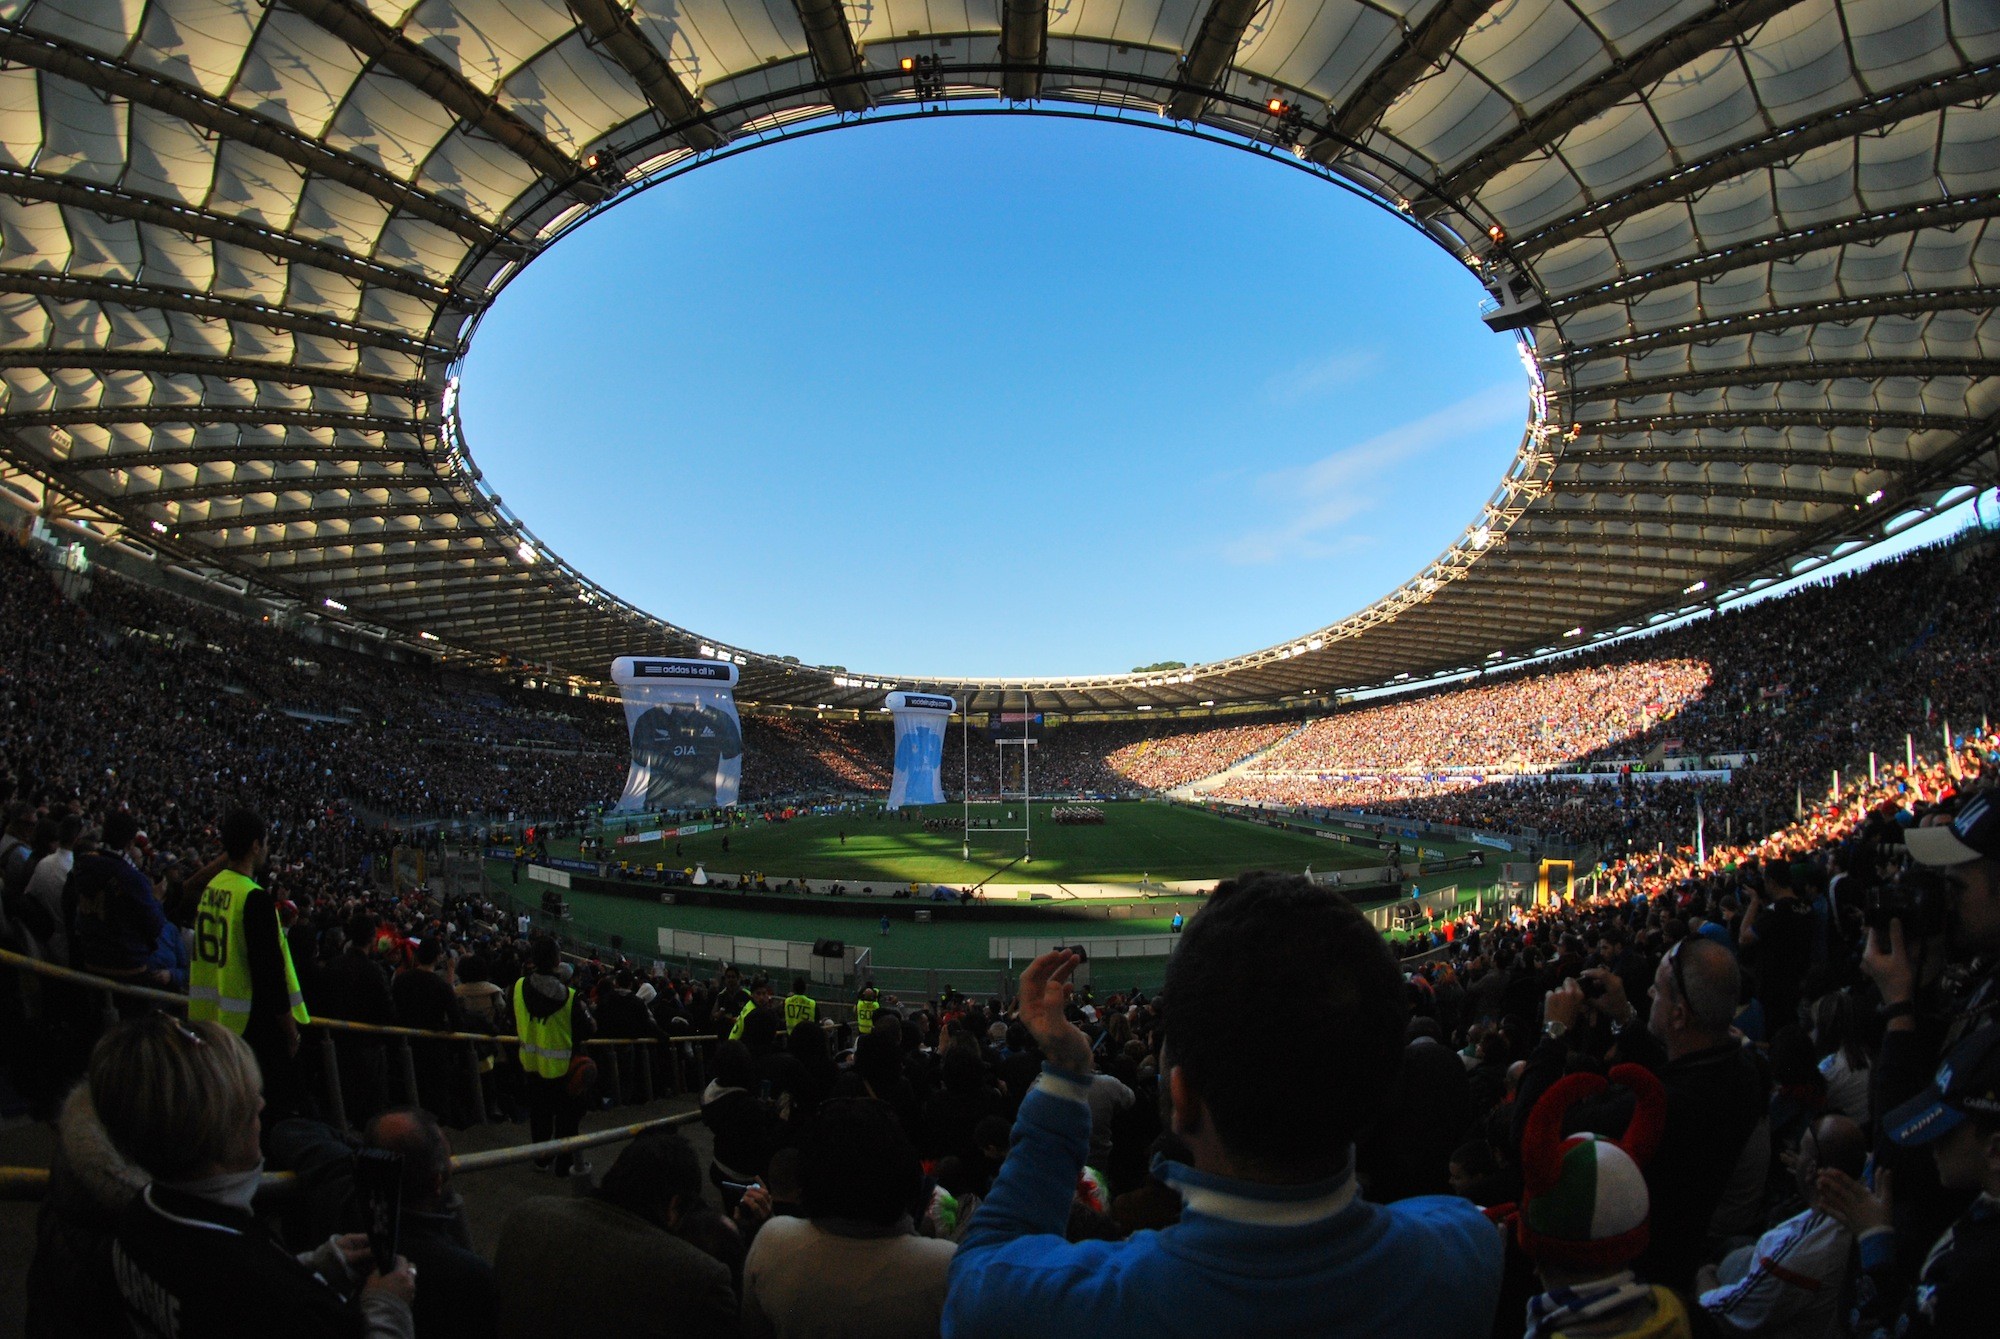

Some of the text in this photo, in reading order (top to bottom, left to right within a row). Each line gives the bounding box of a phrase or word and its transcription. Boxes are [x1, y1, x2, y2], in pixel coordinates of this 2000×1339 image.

[663, 665, 715, 676] adidas is all in
[1324, 832, 1337, 840] adidas
[788, 1004, 810, 1020] 075
[1900, 1106, 1943, 1140] Kappa
